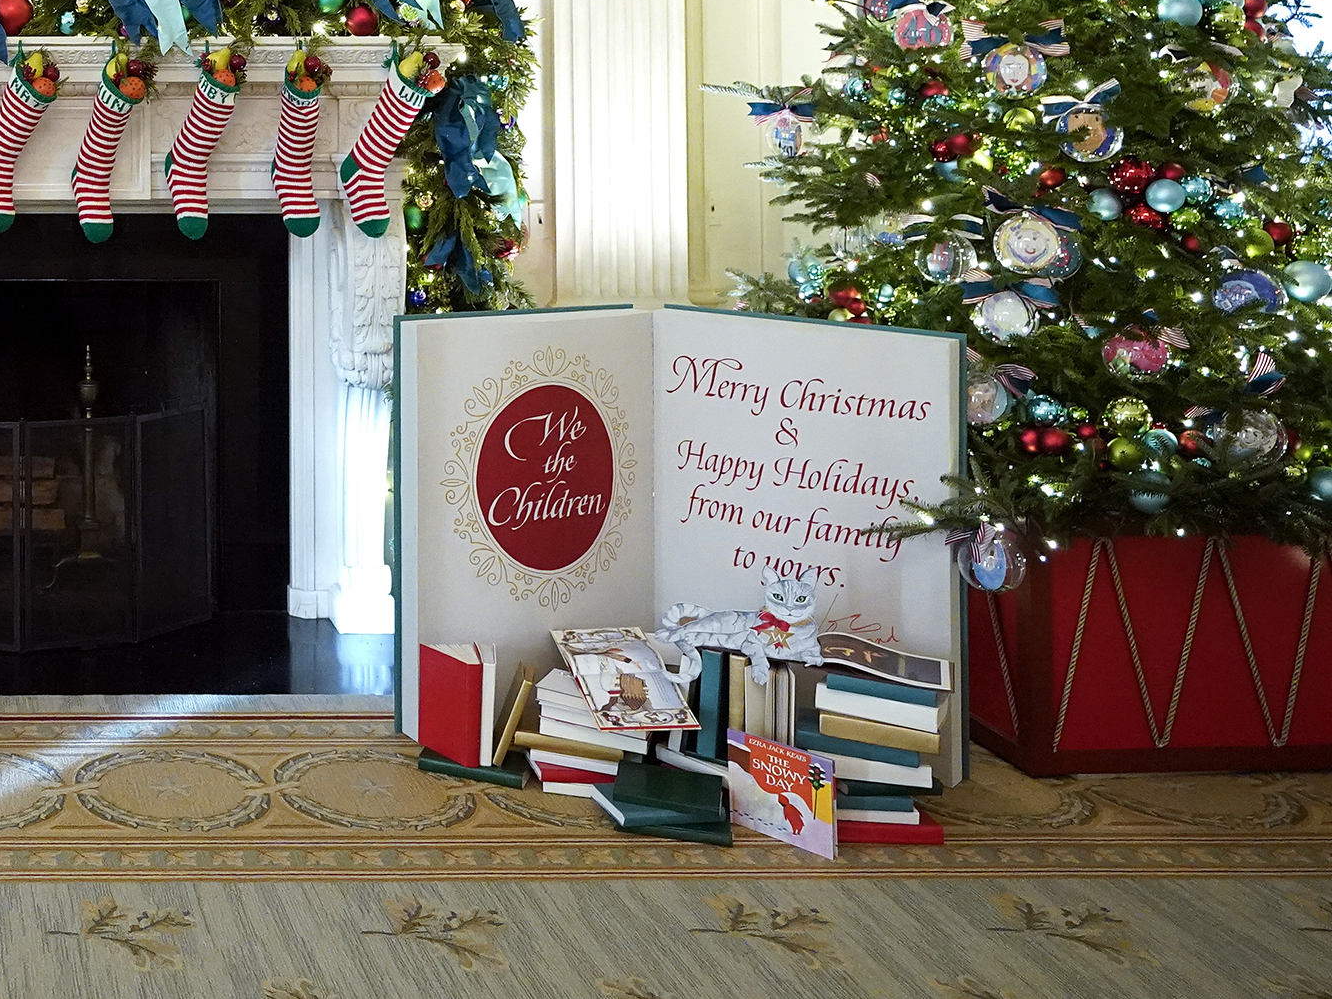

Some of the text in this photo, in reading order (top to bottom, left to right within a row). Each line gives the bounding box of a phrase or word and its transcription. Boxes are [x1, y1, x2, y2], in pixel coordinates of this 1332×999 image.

[666, 356, 932, 422] Merry Christmas
[504, 405, 587, 462] We
[775, 418, 799, 449] &
[541, 441, 578, 483] the
[677, 440, 764, 492] Happy
[488, 480, 606, 531] Children
[680, 484, 744, 526] from
[751, 509, 801, 535] our
[733, 545, 756, 570] to
[770, 631, 786, 643] W
[748, 738, 807, 763] EZRA JACK KEATS
[766, 753, 790, 769] THE
[752, 758, 807, 785] SNOWY
[765, 773, 794, 792] DAY
